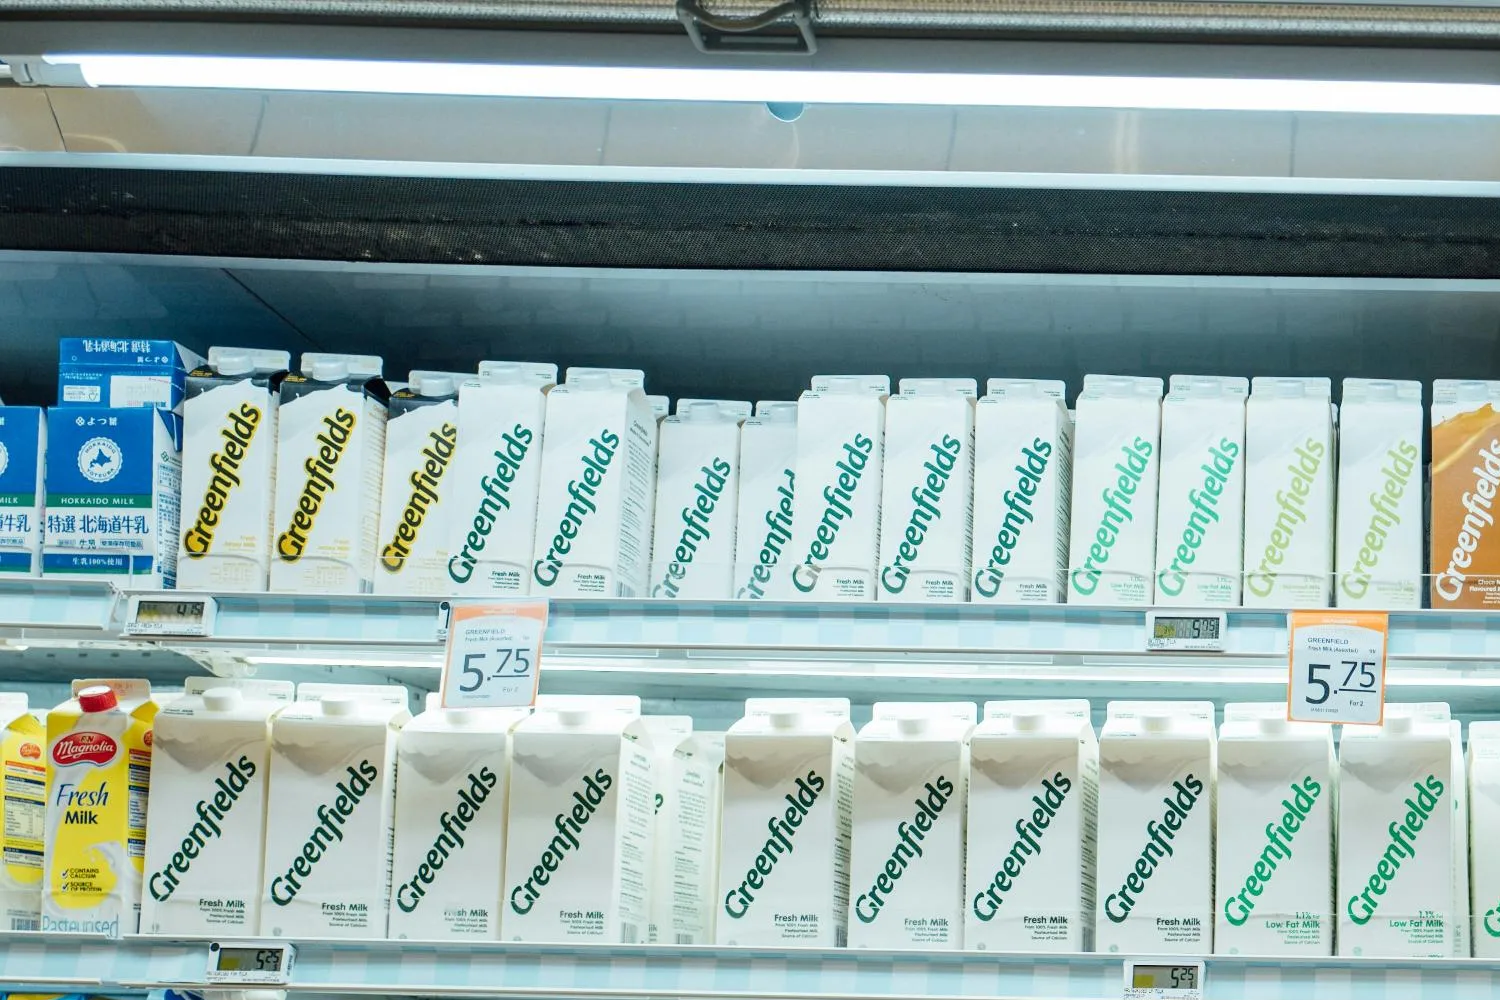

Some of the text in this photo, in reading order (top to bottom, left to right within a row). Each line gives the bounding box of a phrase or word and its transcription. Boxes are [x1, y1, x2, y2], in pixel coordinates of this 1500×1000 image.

[48, 513, 149, 534] 特選 北海道牛乳
[61, 497, 135, 506] HOKKAIDO MILK
[183, 402, 261, 559] Greenfields
[448, 424, 533, 583] Greenfields
[793, 433, 874, 593] Greenfields
[1072, 436, 1153, 597] Greenfields
[1247, 438, 1325, 598] Greenfields
[458, 648, 531, 692] 5.75
[1305, 660, 1377, 705] 5.75
[53, 740, 115, 757] Magnolia
[56, 782, 109, 807] Fresh
[65, 809, 98, 825] Milk
[149, 755, 257, 902] Greenfields
[510, 768, 613, 915] Greenfields
[1105, 773, 1204, 923] Greenfields
[1348, 774, 1444, 926] Greenfields
[322, 902, 368, 911] Fresh Milk
[1390, 919, 1444, 928] Low Fat Milk
